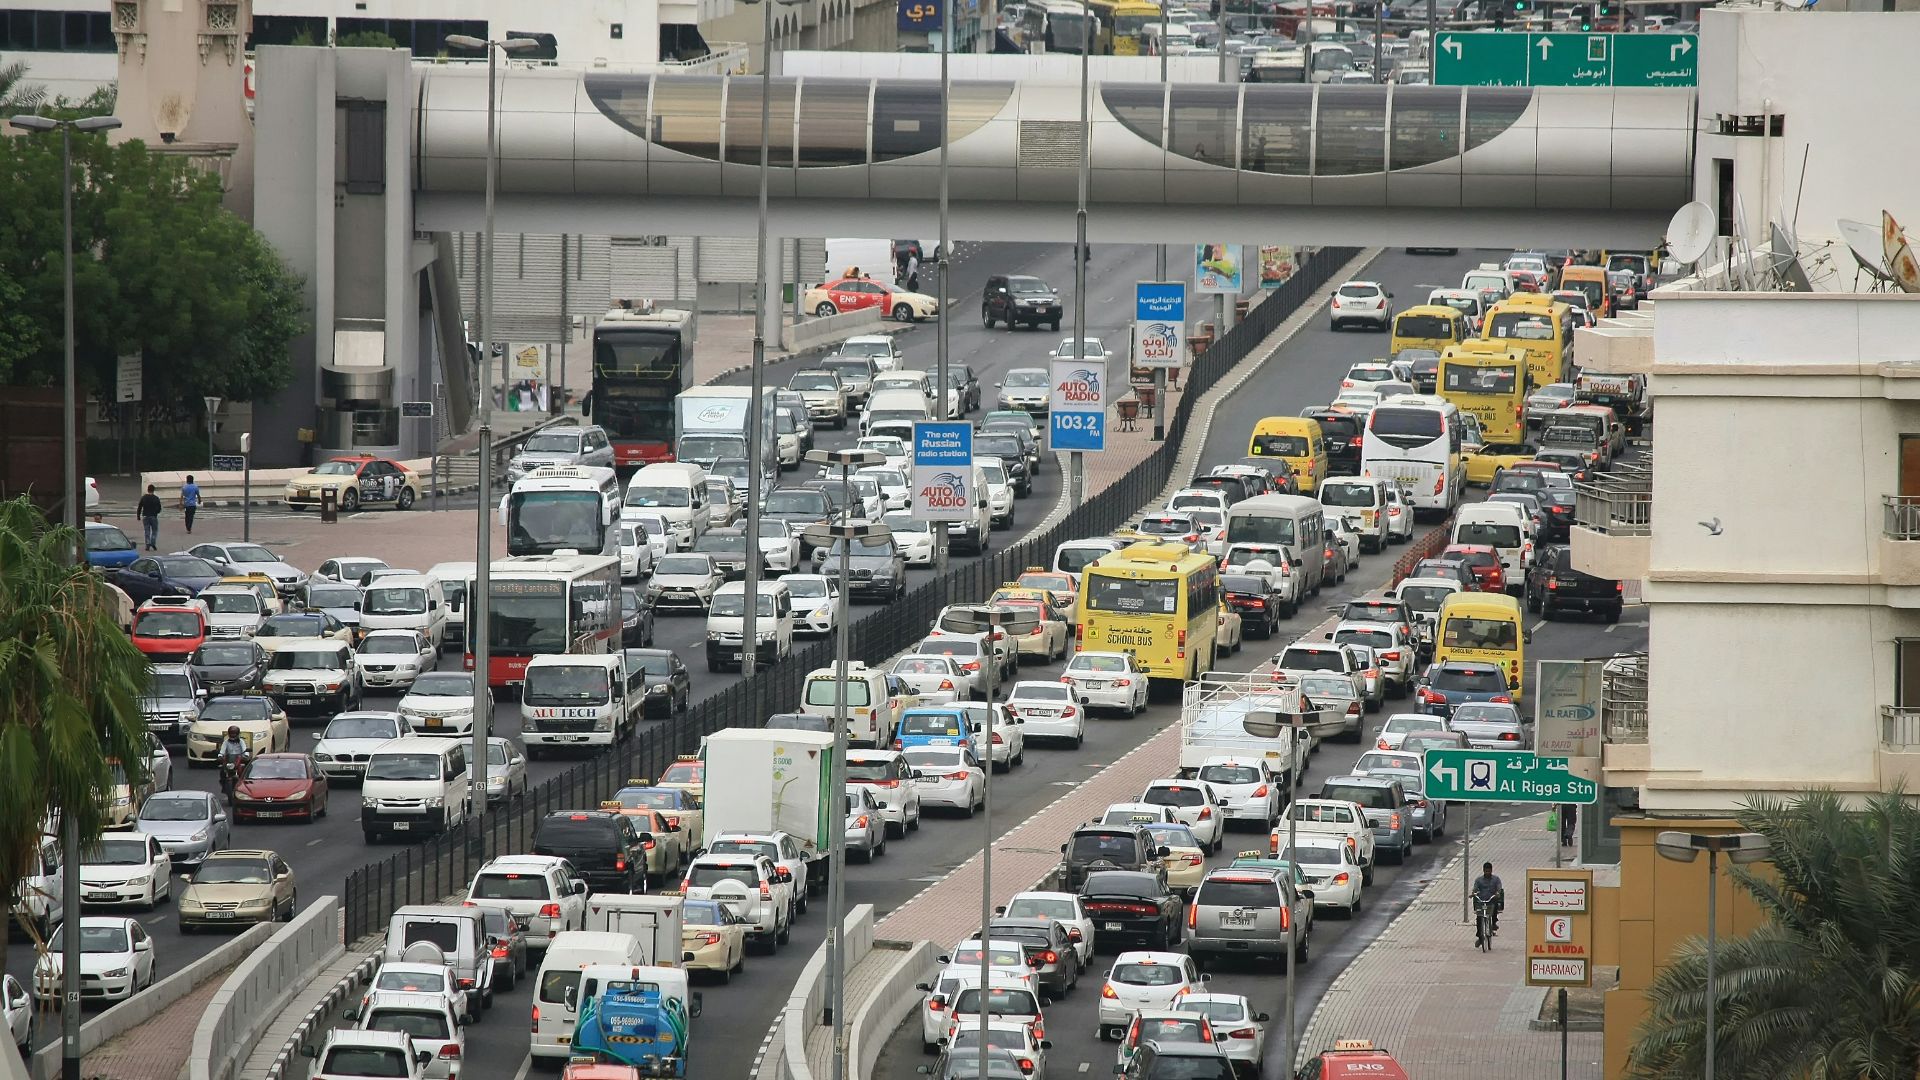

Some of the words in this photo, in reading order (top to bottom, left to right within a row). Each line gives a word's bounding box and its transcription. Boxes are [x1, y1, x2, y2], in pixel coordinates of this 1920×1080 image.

[839, 294, 857, 303] ENG
[1056, 381, 1088, 392] AUTO
[1589, 381, 1621, 392] TOYOTA
[1065, 391, 1100, 401] RADIO
[1054, 415, 1097, 430] 103.2
[942, 431, 960, 440] only
[1089, 429, 1100, 437] FM
[921, 439, 961, 448] Russian
[919, 486, 953, 497] AUTO
[928, 496, 967, 507] RADIO
[1107, 634, 1136, 645] SCHOOL
[1137, 637, 1153, 646] BUS
[1506, 757, 1539, 774] الرقة
[1500, 780, 1515, 793] Al
[1522, 782, 1561, 797] Rigga
[1567, 781, 1593, 794] Stn
[1533, 883, 1585, 897] صيدلية
[1534, 897, 1583, 908] الروضة
[1533, 944, 1545, 953] AL
[1548, 945, 1584, 954] RAWDA
[1532, 963, 1583, 976] PHARMACY
[68, 993, 79, 1001] 64
[1346, 1063, 1385, 1071] ENG
